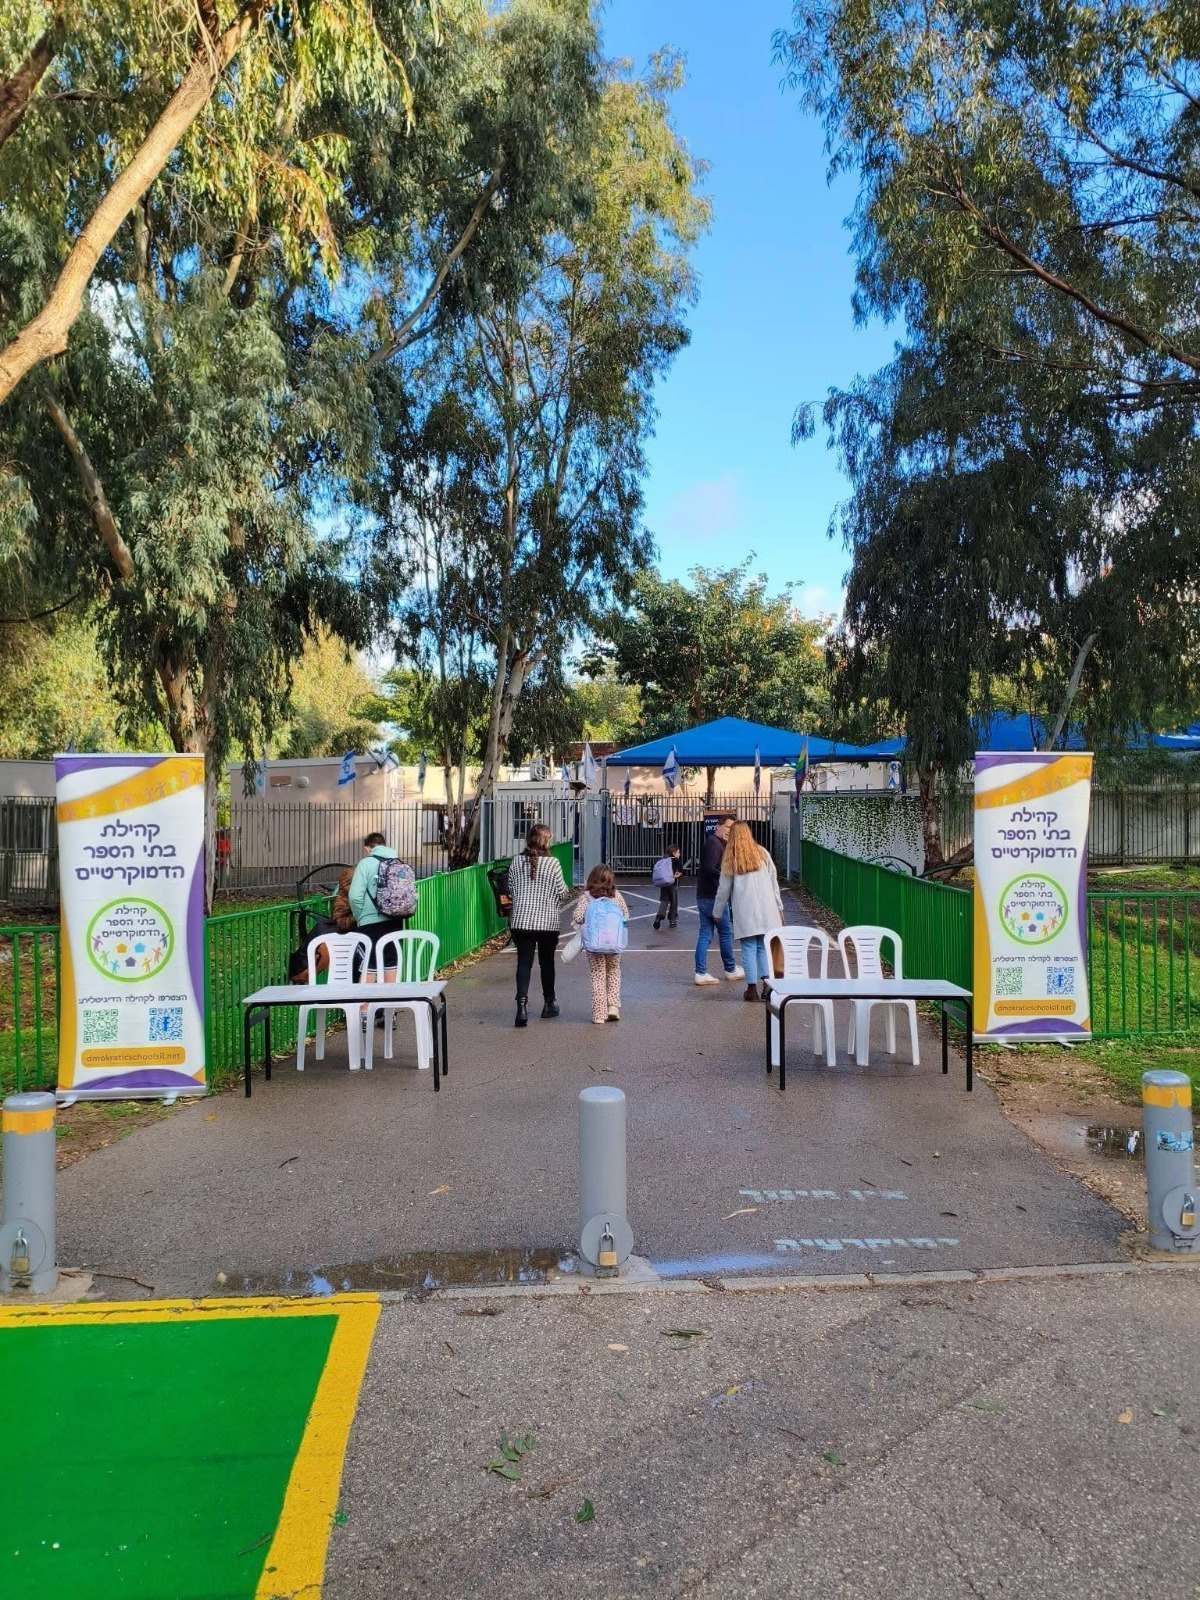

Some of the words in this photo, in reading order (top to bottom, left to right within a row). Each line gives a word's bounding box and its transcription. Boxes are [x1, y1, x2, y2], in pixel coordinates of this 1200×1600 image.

[1010, 806, 1058, 828] קהילת
[100, 818, 161, 843] קהילת
[997, 829, 1036, 840] הספר
[1043, 829, 1071, 840] בתי
[83, 845, 135, 859] הספר
[143, 844, 176, 858] בתי
[991, 847, 1077, 864] הדמוקרטיים
[75, 865, 185, 886] הדמוקרטיים
[1020, 879, 1046, 890] קהילת
[115, 904, 147, 917] קהילת
[1010, 901, 1057, 910] הדמוקרטיים
[106, 919, 133, 927] הספר
[138, 918, 156, 926] בתי
[101, 929, 160, 941] הדמוקרטיים
[125, 993, 155, 1005] לקהילה
